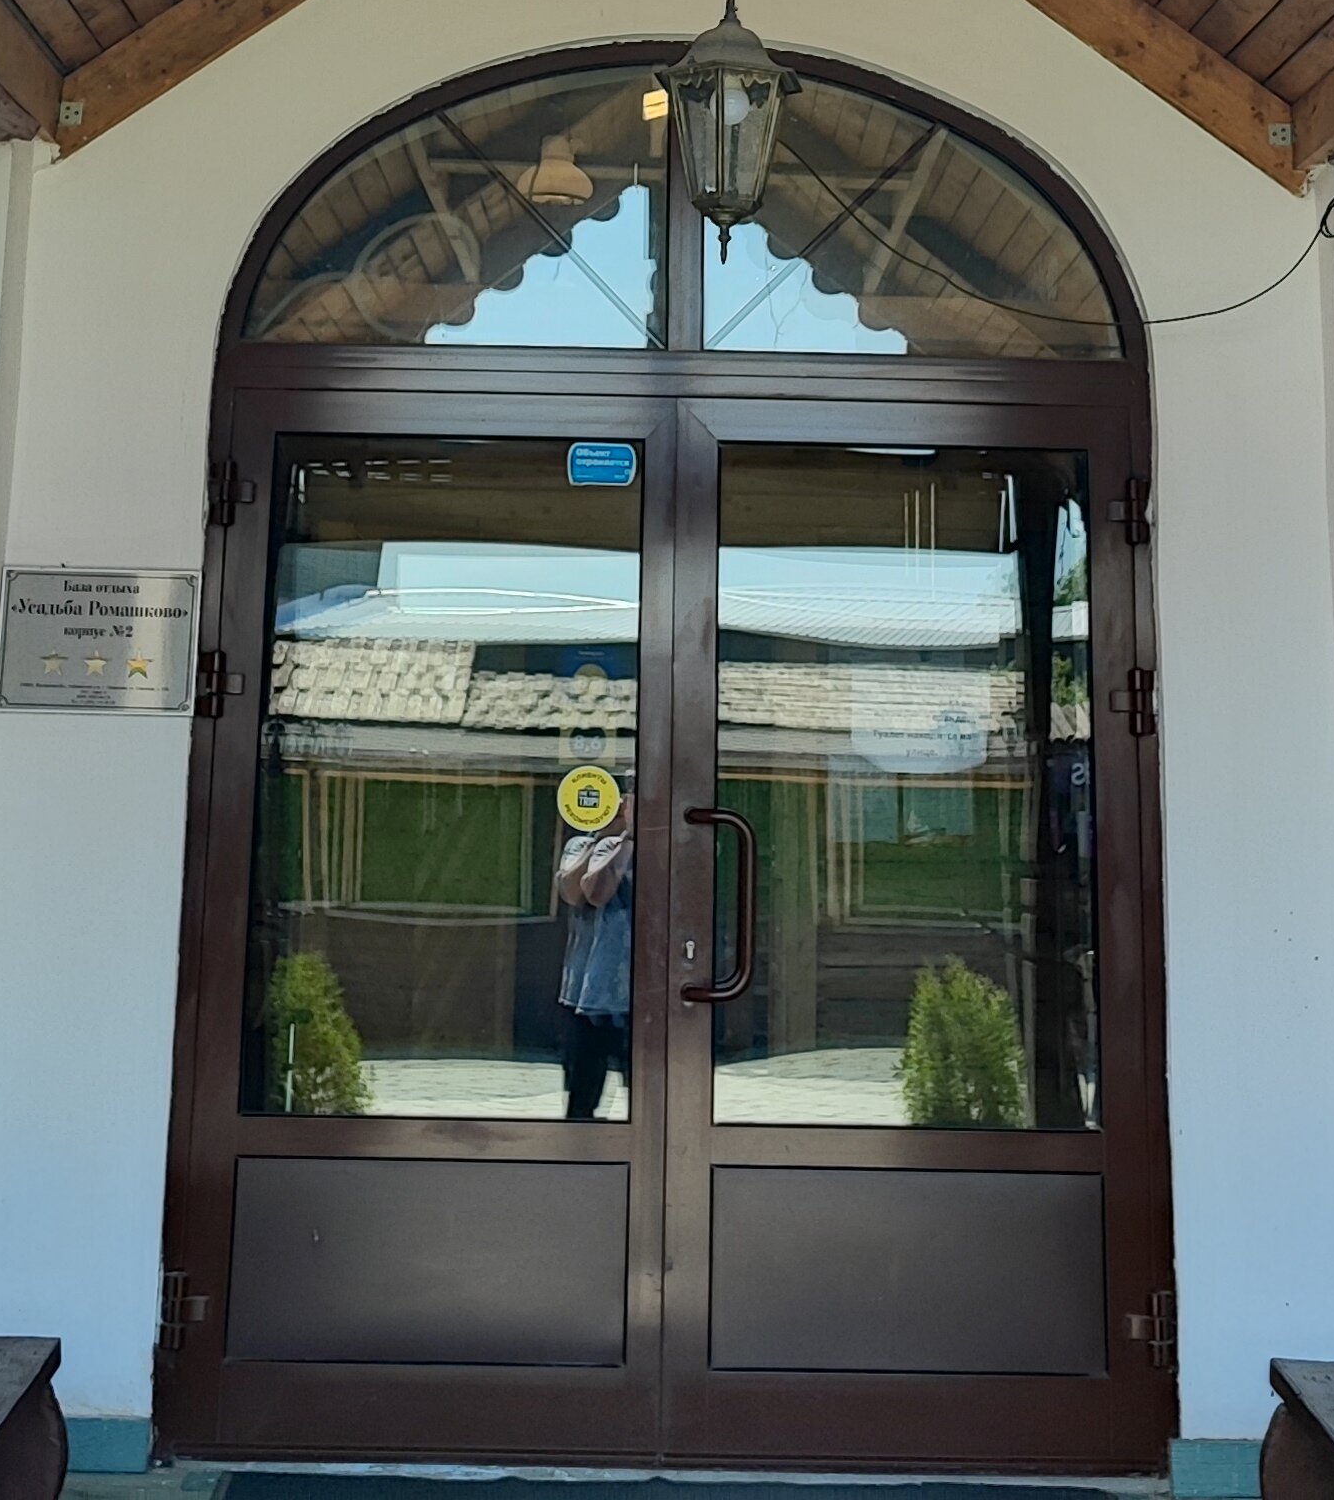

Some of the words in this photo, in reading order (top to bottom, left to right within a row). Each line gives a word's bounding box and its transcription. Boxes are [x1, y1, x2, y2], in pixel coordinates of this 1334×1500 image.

[63, 580, 92, 592] База
[96, 583, 140, 594] отдыха
[11, 598, 83, 616] «Усадьба
[89, 601, 189, 619] Ромашково»
[63, 626, 106, 639] корпус
